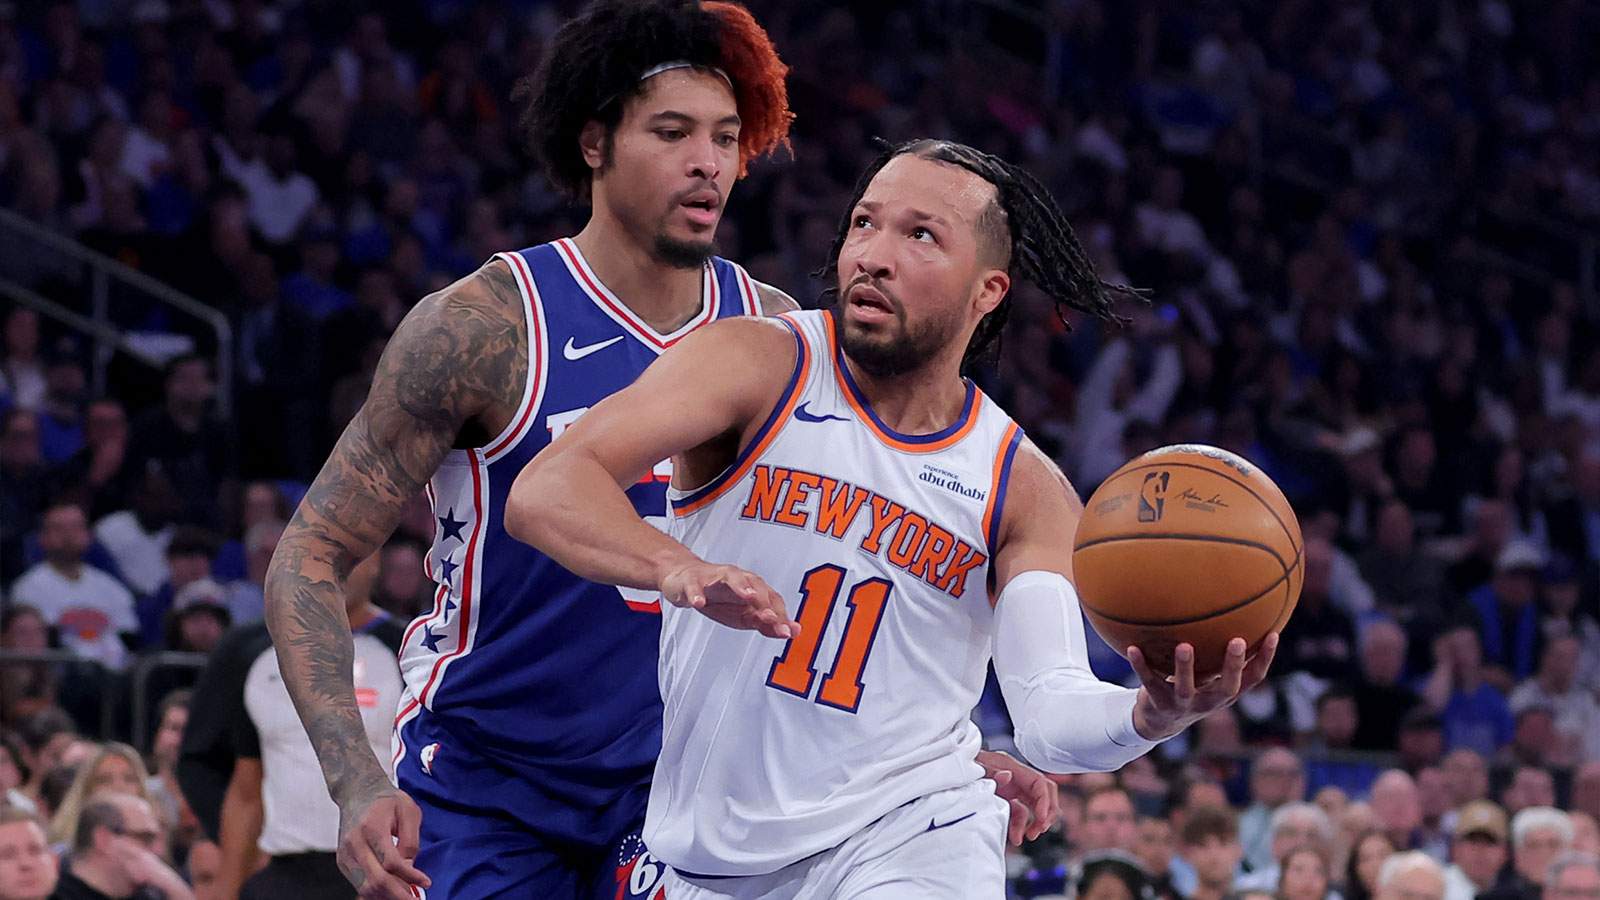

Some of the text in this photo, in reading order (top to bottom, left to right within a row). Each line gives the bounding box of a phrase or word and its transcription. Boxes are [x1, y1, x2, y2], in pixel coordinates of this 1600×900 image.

[919, 472, 987, 501] abu dhabi
[923, 464, 960, 480] experience
[739, 464, 988, 598] NEW YORK
[765, 562, 894, 714] 11
